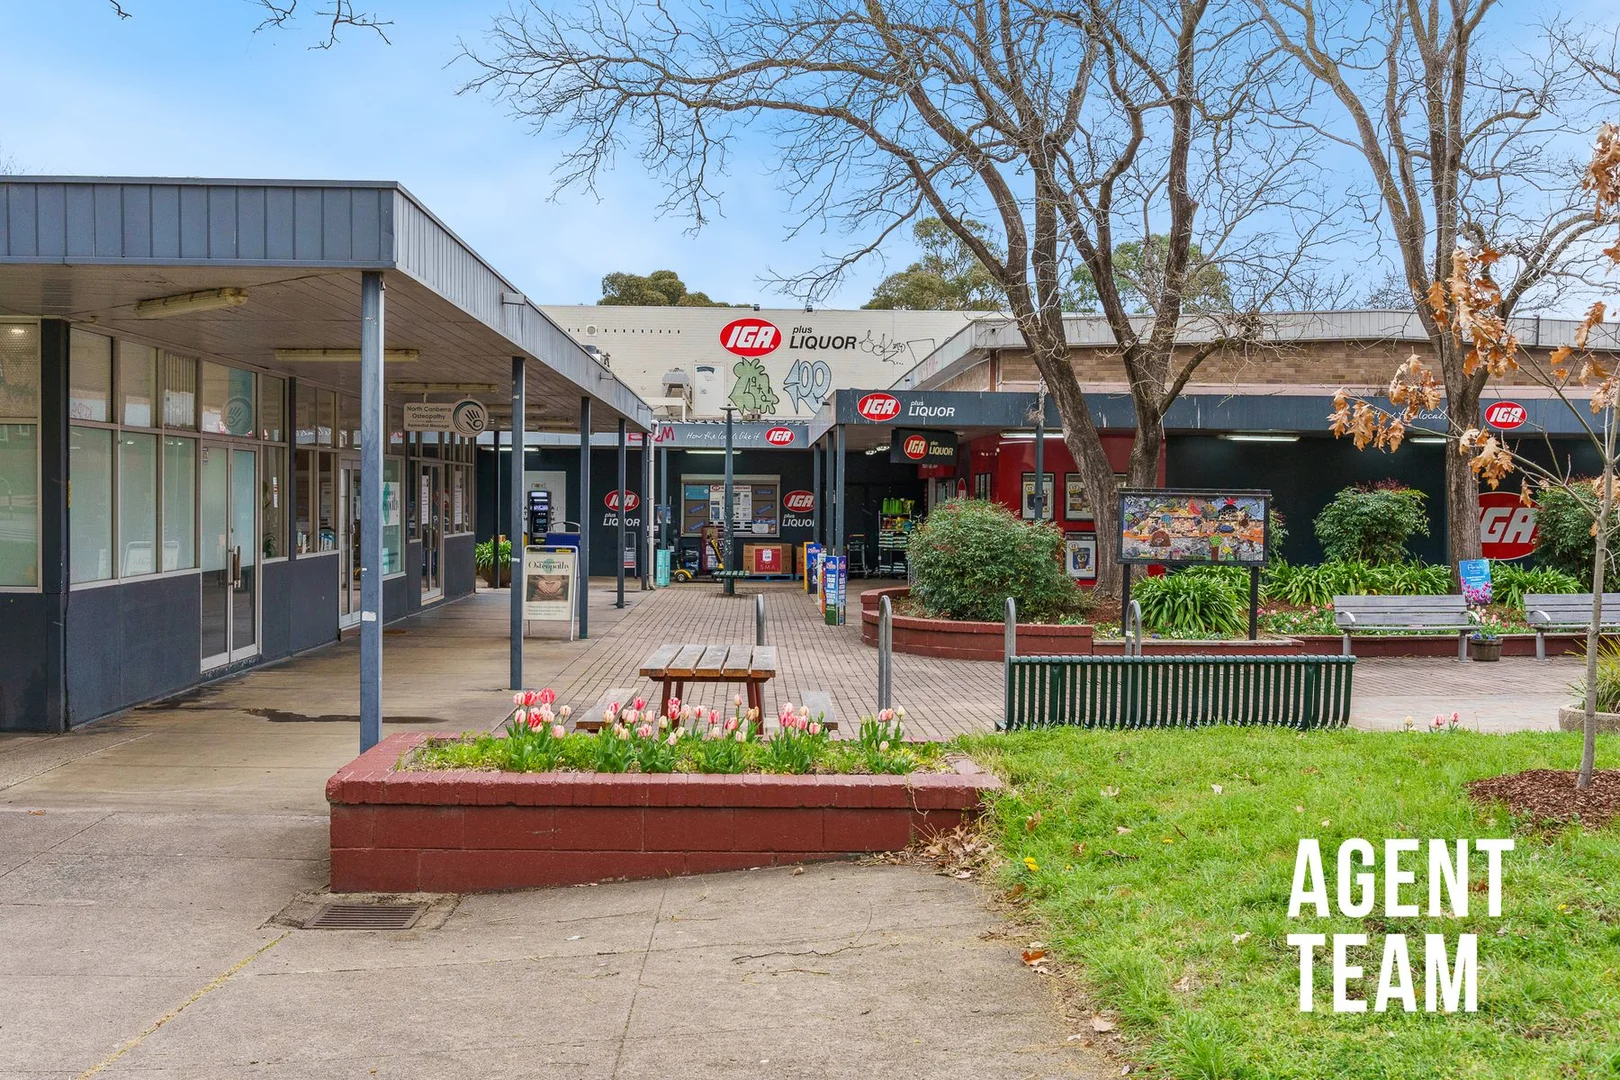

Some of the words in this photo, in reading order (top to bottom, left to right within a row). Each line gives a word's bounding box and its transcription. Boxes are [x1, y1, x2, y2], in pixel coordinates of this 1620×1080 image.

[792, 325, 812, 335] plus
[726, 325, 775, 349] IGA
[789, 336, 857, 350] LIQUOR
[862, 399, 896, 415] IGA
[908, 406, 956, 417] LIQUOR
[1489, 407, 1524, 423] IGA
[686, 431, 703, 440] How
[704, 431, 717, 441] the
[739, 431, 752, 440] like
[768, 430, 792, 442] IGA
[907, 440, 926, 454] IGA
[929, 446, 954, 456] LIQUOR
[602, 517, 641, 527] LIQOR
[782, 518, 814, 527] LIQUO
[1480, 507, 1537, 544] GA
[528, 560, 569, 572] Osteopathy
